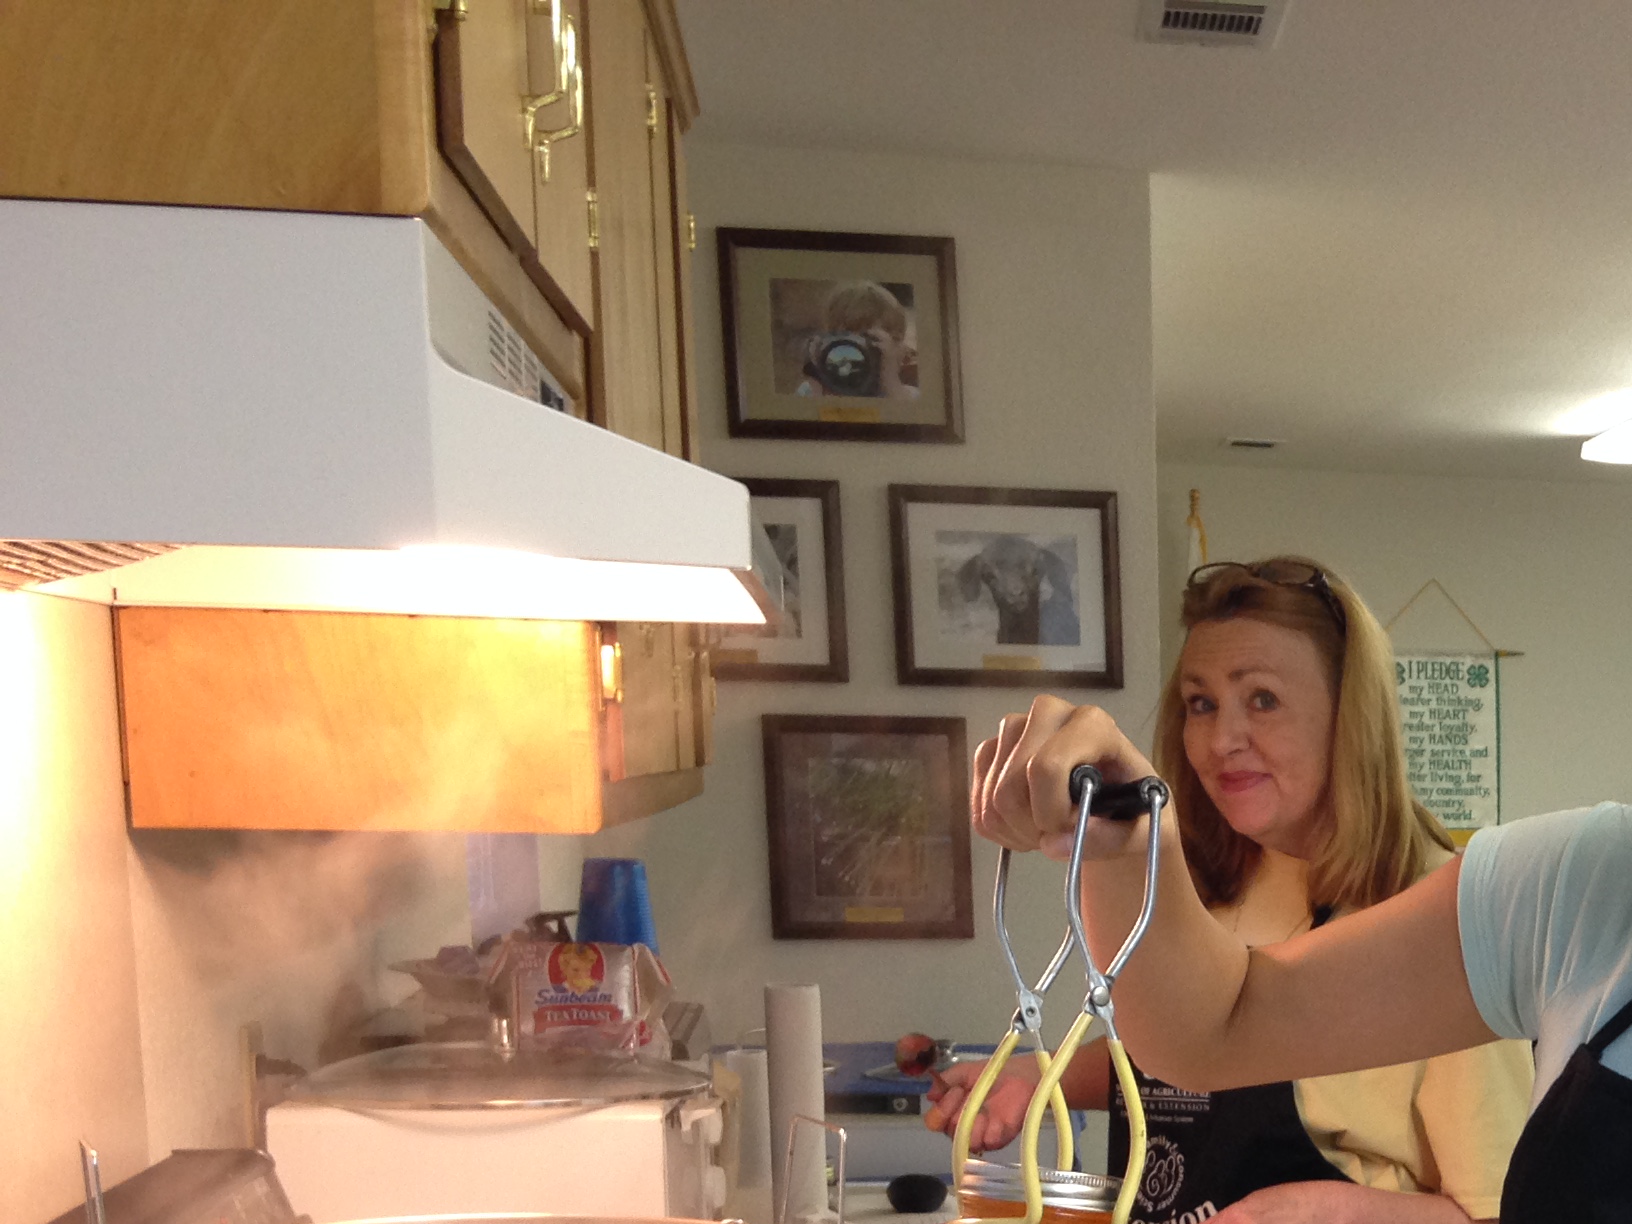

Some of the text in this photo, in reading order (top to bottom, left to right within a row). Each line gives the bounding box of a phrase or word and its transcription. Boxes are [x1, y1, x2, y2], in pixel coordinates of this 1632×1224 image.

[1416, 660, 1465, 681] PLEDGE
[1409, 682, 1459, 696] my HEAD
[1409, 709, 1467, 723] my HEART
[1408, 734, 1468, 749] my HANDS
[1429, 760, 1471, 770] HEALTH
[535, 989, 613, 1006] Sunbeam
